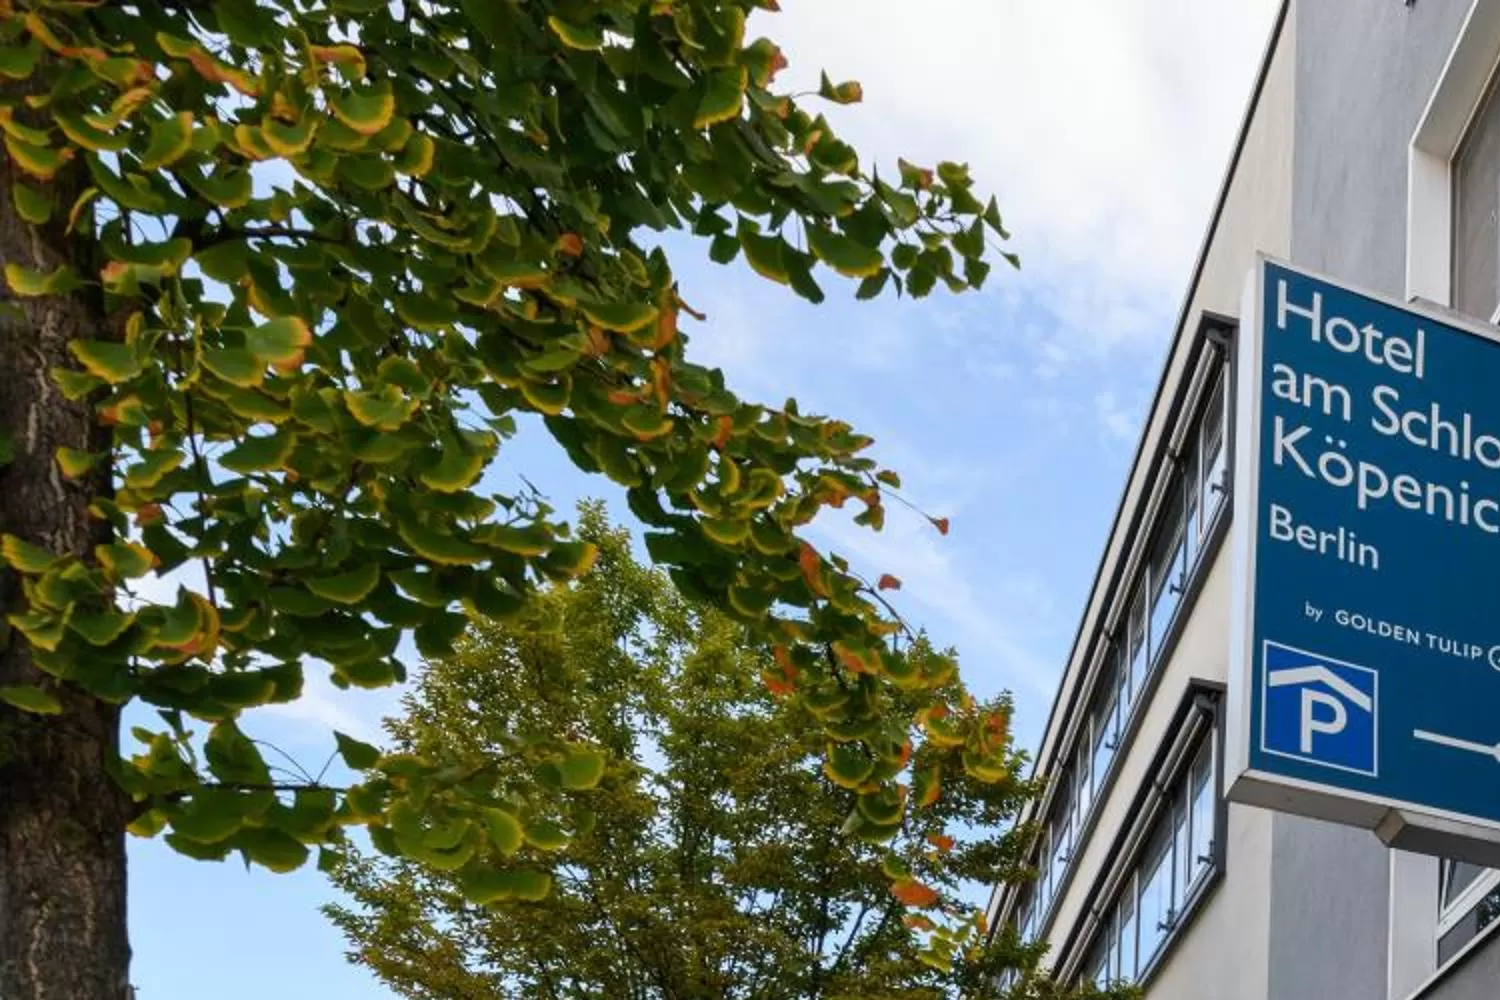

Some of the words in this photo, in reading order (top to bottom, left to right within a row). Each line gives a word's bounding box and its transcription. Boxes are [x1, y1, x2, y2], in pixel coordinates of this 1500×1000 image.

[1277, 279, 1425, 379] Hotel
[1272, 363, 1352, 421] am
[1270, 504, 1380, 570] Berlin
[1304, 600, 1323, 623] by
[1335, 609, 1420, 646] GOLDEN
[1425, 632, 1484, 661] TULIP
[1300, 687, 1348, 754] P
